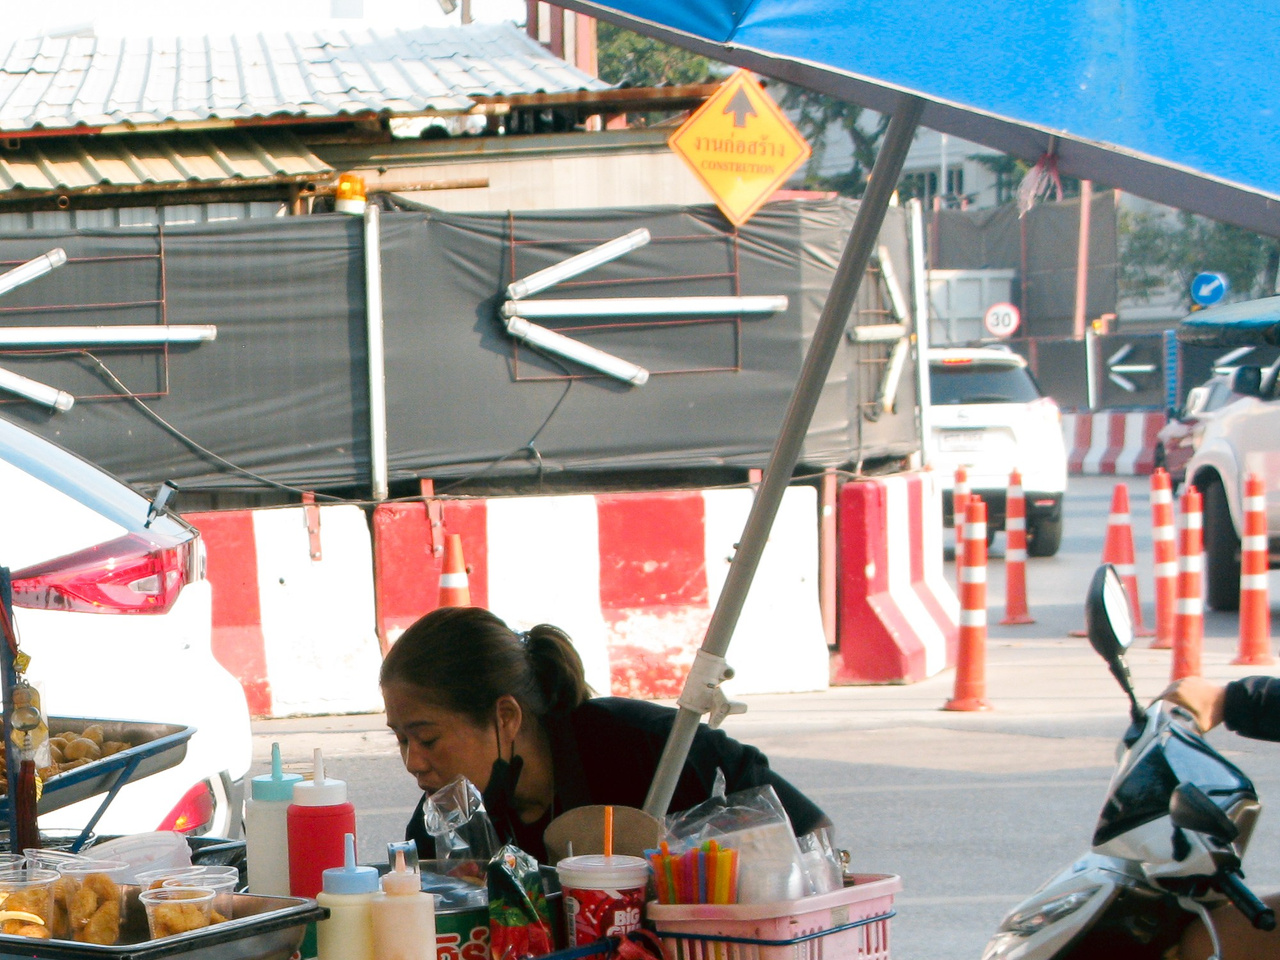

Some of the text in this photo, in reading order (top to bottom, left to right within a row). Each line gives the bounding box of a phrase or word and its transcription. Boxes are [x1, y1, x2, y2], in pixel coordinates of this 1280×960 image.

[694, 131, 786, 158] งานก่อสร้าง
[991, 312, 1012, 328] 30
